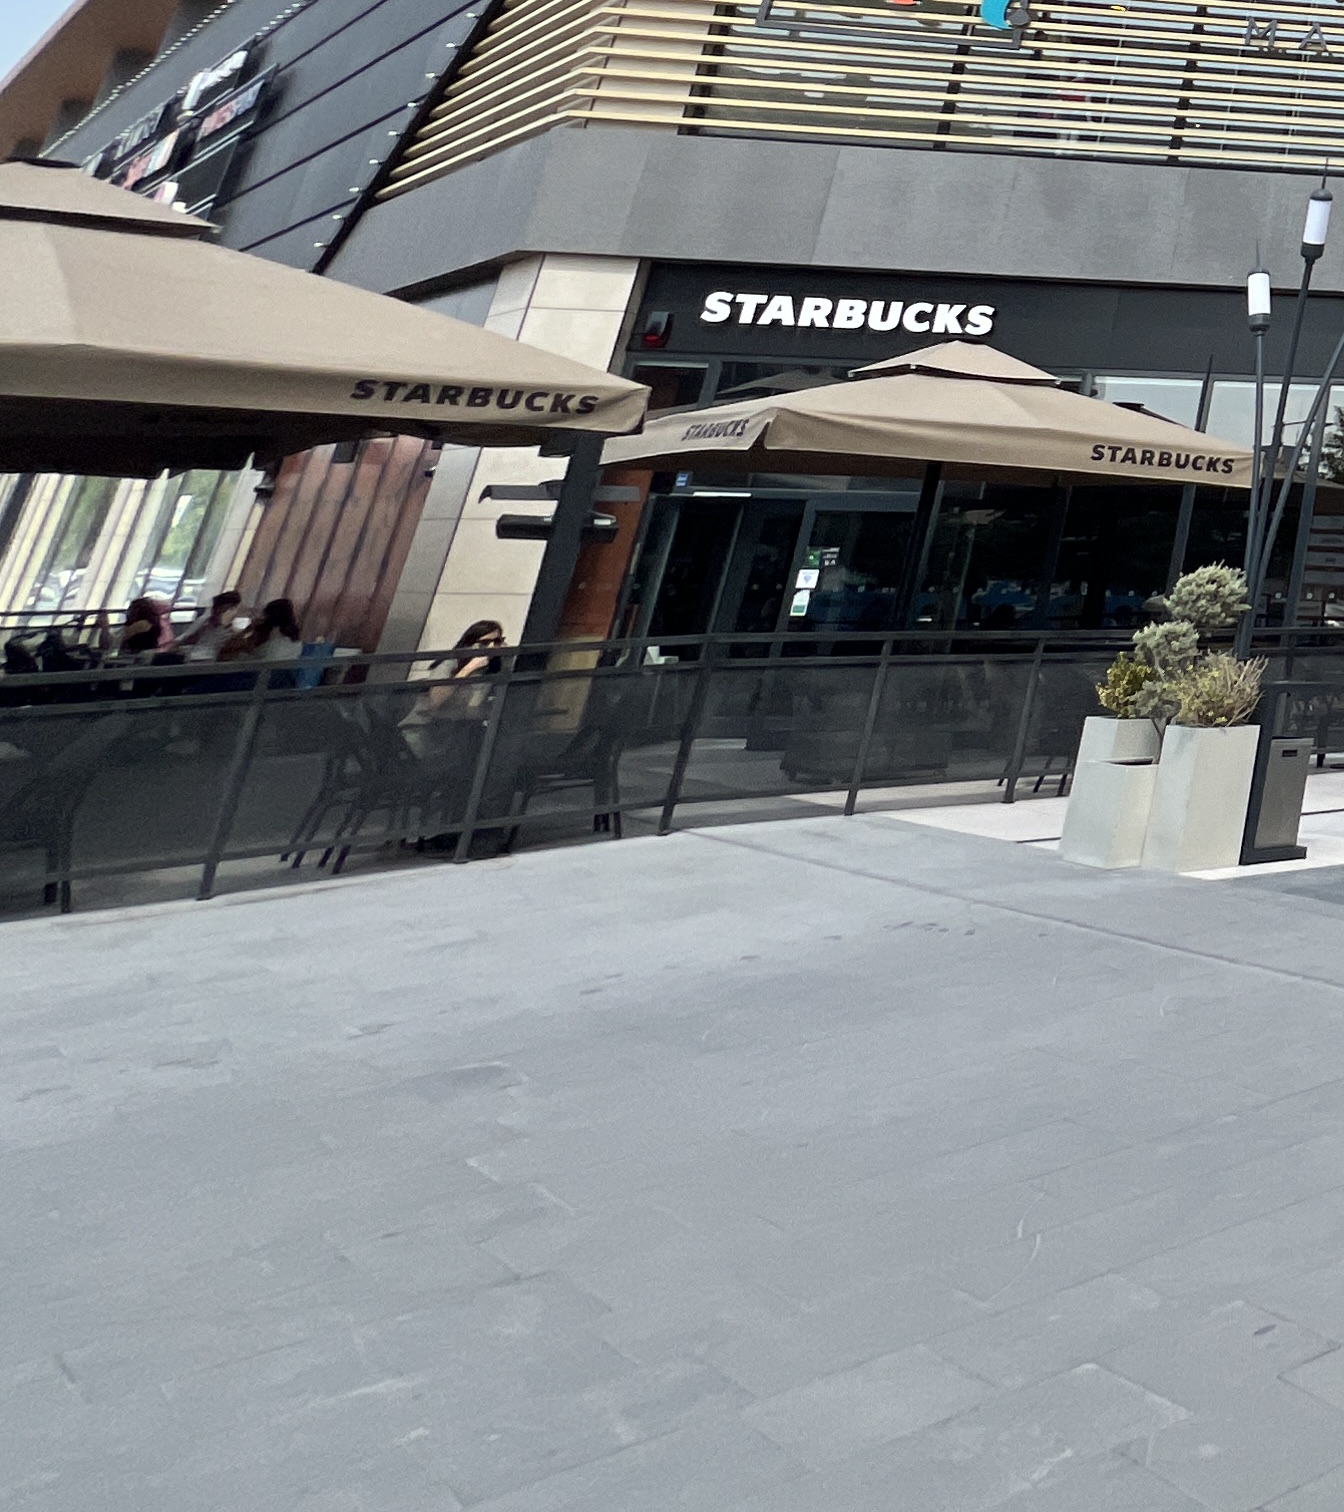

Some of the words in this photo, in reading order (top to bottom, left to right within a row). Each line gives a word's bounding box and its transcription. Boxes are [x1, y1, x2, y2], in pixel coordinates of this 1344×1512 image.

[700, 291, 996, 336] STARBUCKS
[349, 377, 600, 416] STARBUCKS
[680, 417, 750, 443] STARBUCKS
[1089, 442, 1235, 475] STARBUCKS
